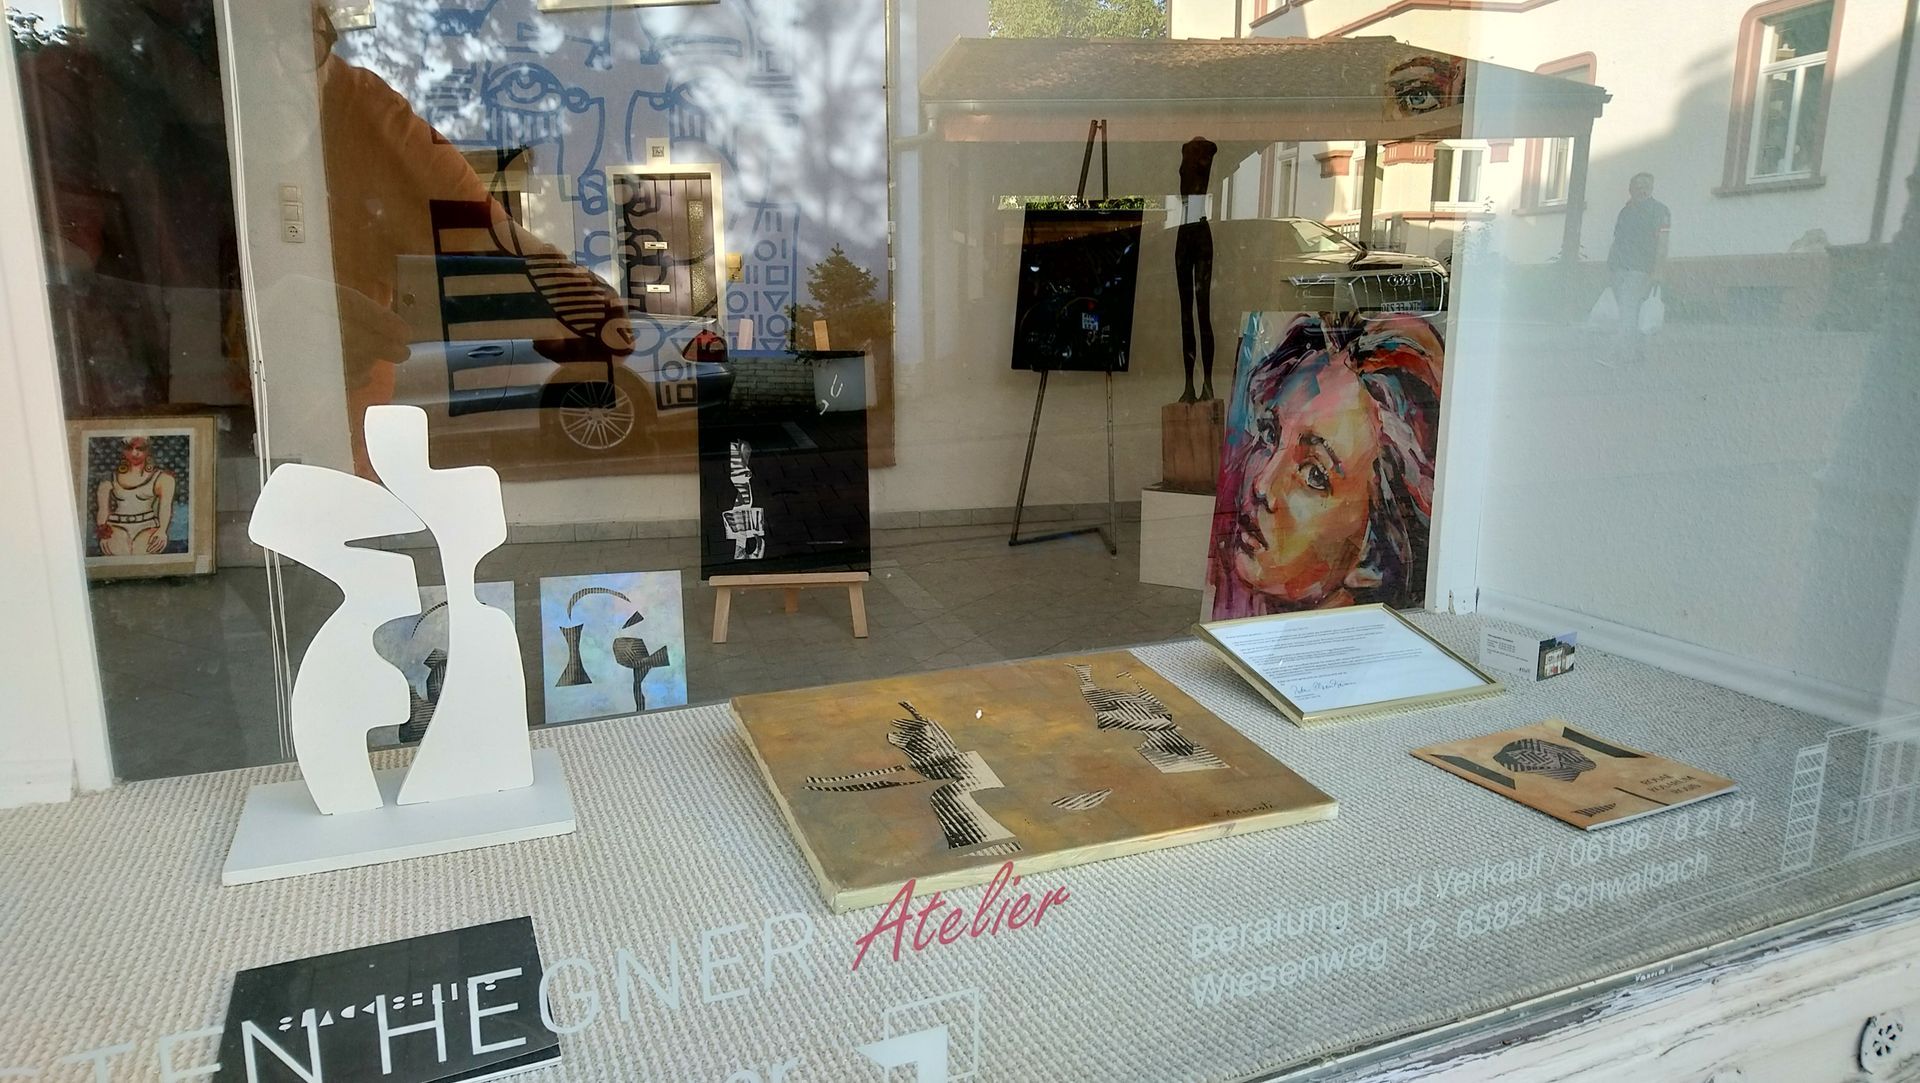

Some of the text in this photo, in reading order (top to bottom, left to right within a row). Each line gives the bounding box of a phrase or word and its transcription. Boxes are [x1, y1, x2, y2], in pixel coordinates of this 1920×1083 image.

[852, 861, 1070, 971] Atelier
[1191, 901, 1349, 961] Beratung
[1363, 872, 1422, 919] und
[1433, 846, 1545, 898] Verkauf
[1570, 823, 1650, 866] 06196
[1674, 812, 1689, 841] 8
[1696, 805, 1721, 836] 21
[1731, 798, 1755, 828] 21
[1191, 849, 1708, 1009] Wiesenweg 12 65824 Schwalbach
[375, 912, 814, 1074] HEGNER
